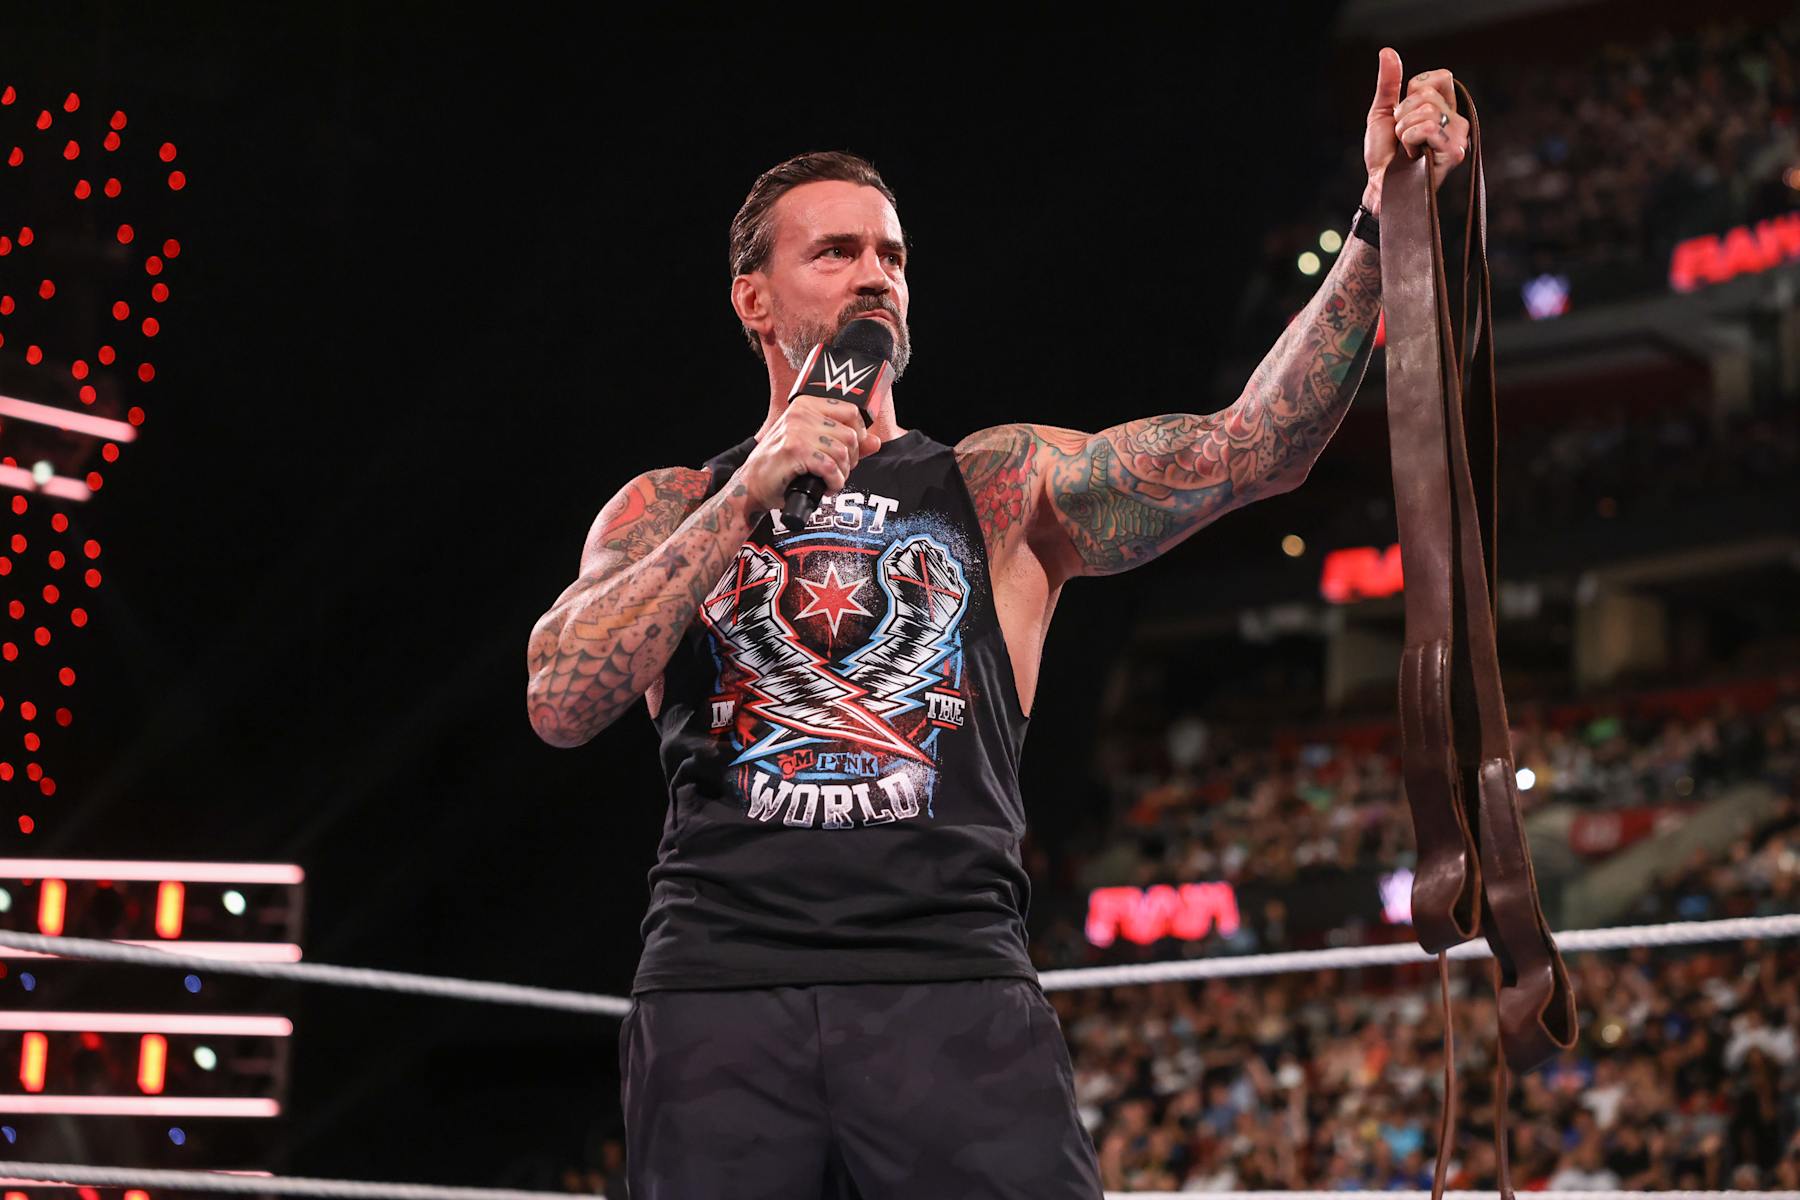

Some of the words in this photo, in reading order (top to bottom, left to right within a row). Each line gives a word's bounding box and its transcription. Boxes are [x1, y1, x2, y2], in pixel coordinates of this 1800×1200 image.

[711, 700, 735, 728] IN
[924, 691, 966, 726] THE
[747, 771, 920, 829] WORLD
